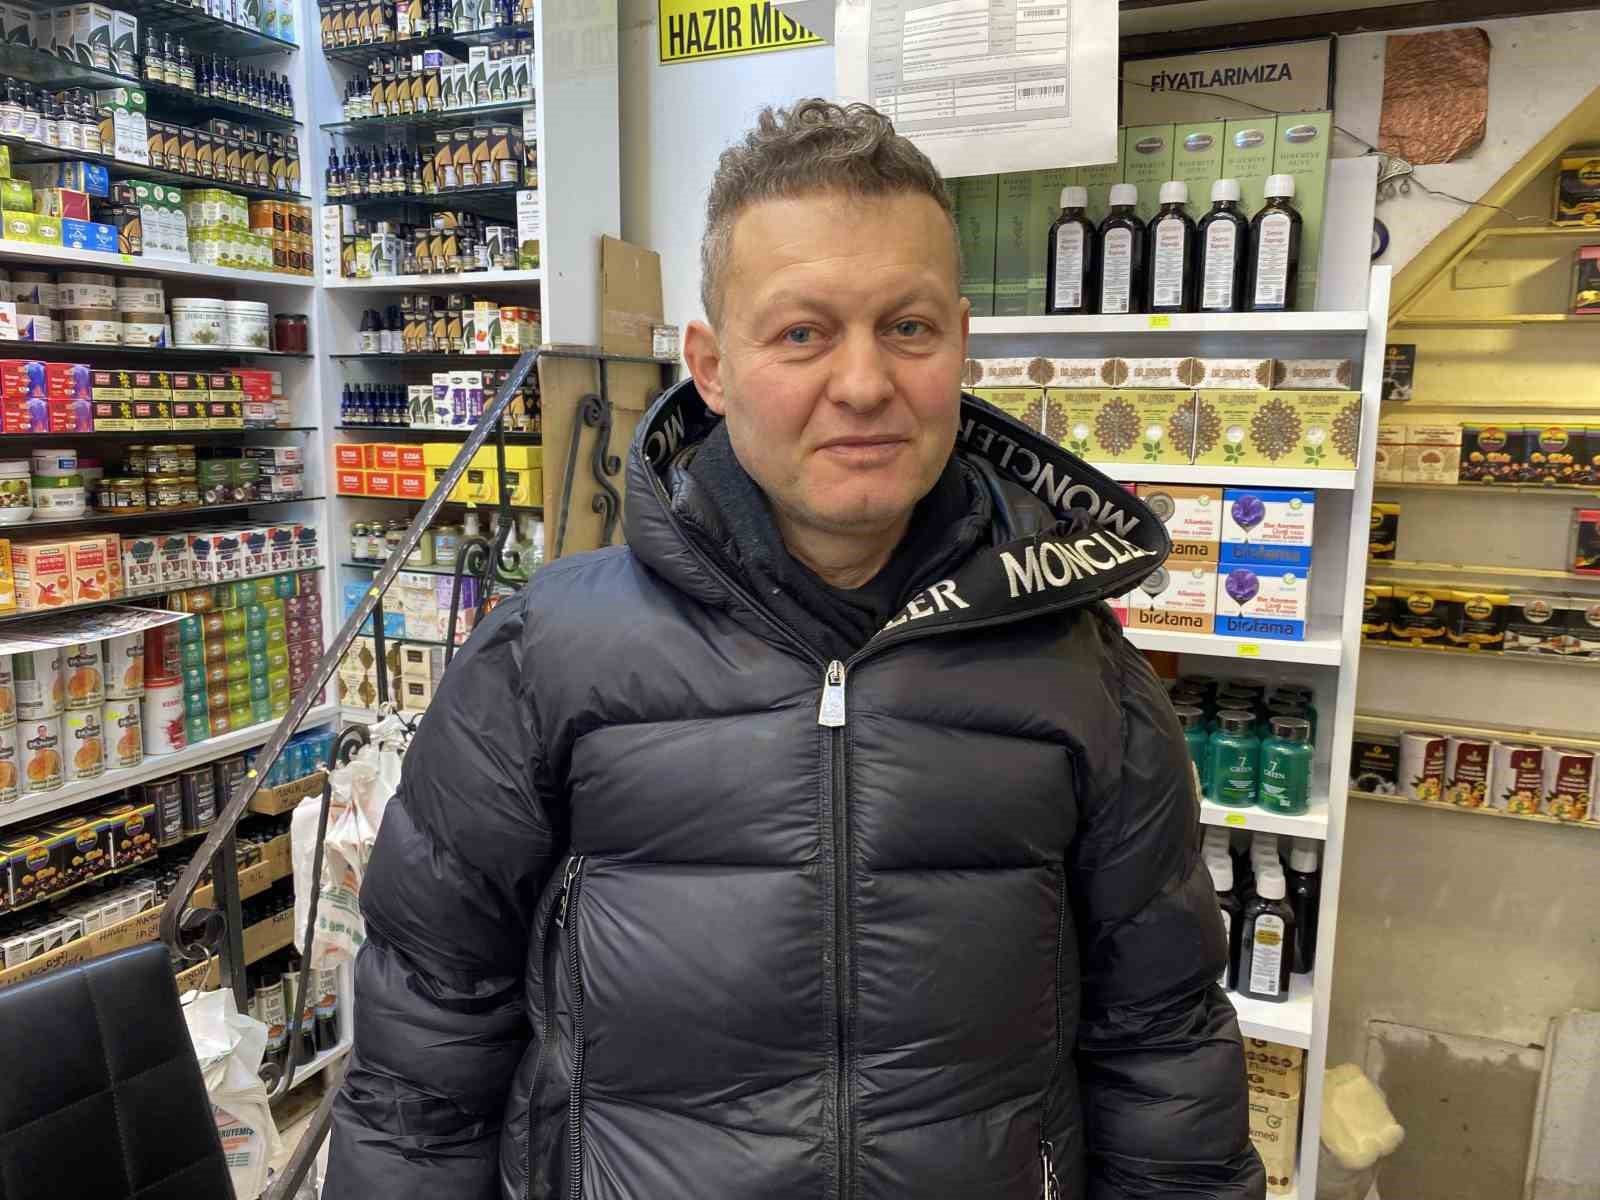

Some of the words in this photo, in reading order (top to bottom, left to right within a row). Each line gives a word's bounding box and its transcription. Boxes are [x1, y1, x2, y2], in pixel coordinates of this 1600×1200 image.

[669, 6, 742, 56] HAZIR
[1151, 62, 1293, 93] FİYATLARIMIZA
[1139, 608, 1204, 628] biotama
[1227, 616, 1294, 635] biotama
